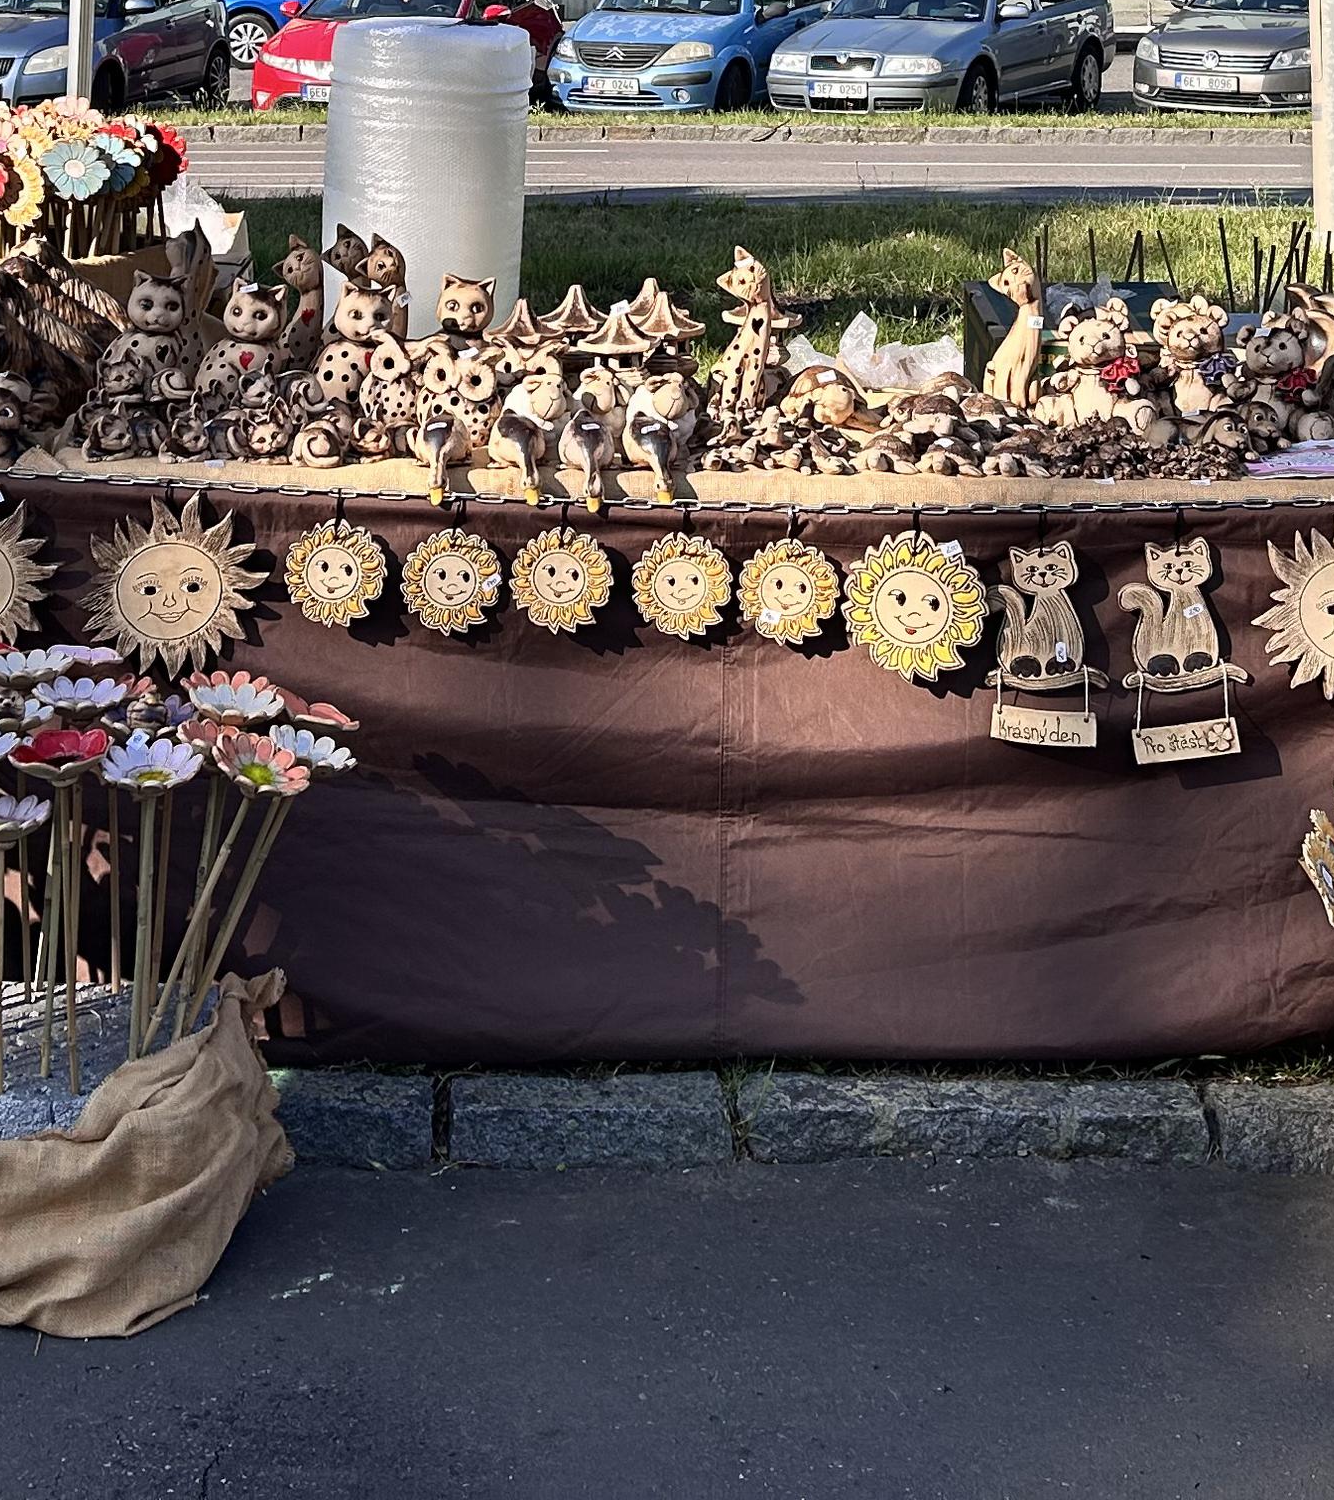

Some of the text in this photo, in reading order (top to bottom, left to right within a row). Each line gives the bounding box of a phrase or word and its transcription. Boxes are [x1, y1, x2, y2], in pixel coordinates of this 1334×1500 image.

[998, 716, 1082, 745] Krásný den
[1142, 735, 1166, 756] Pro
